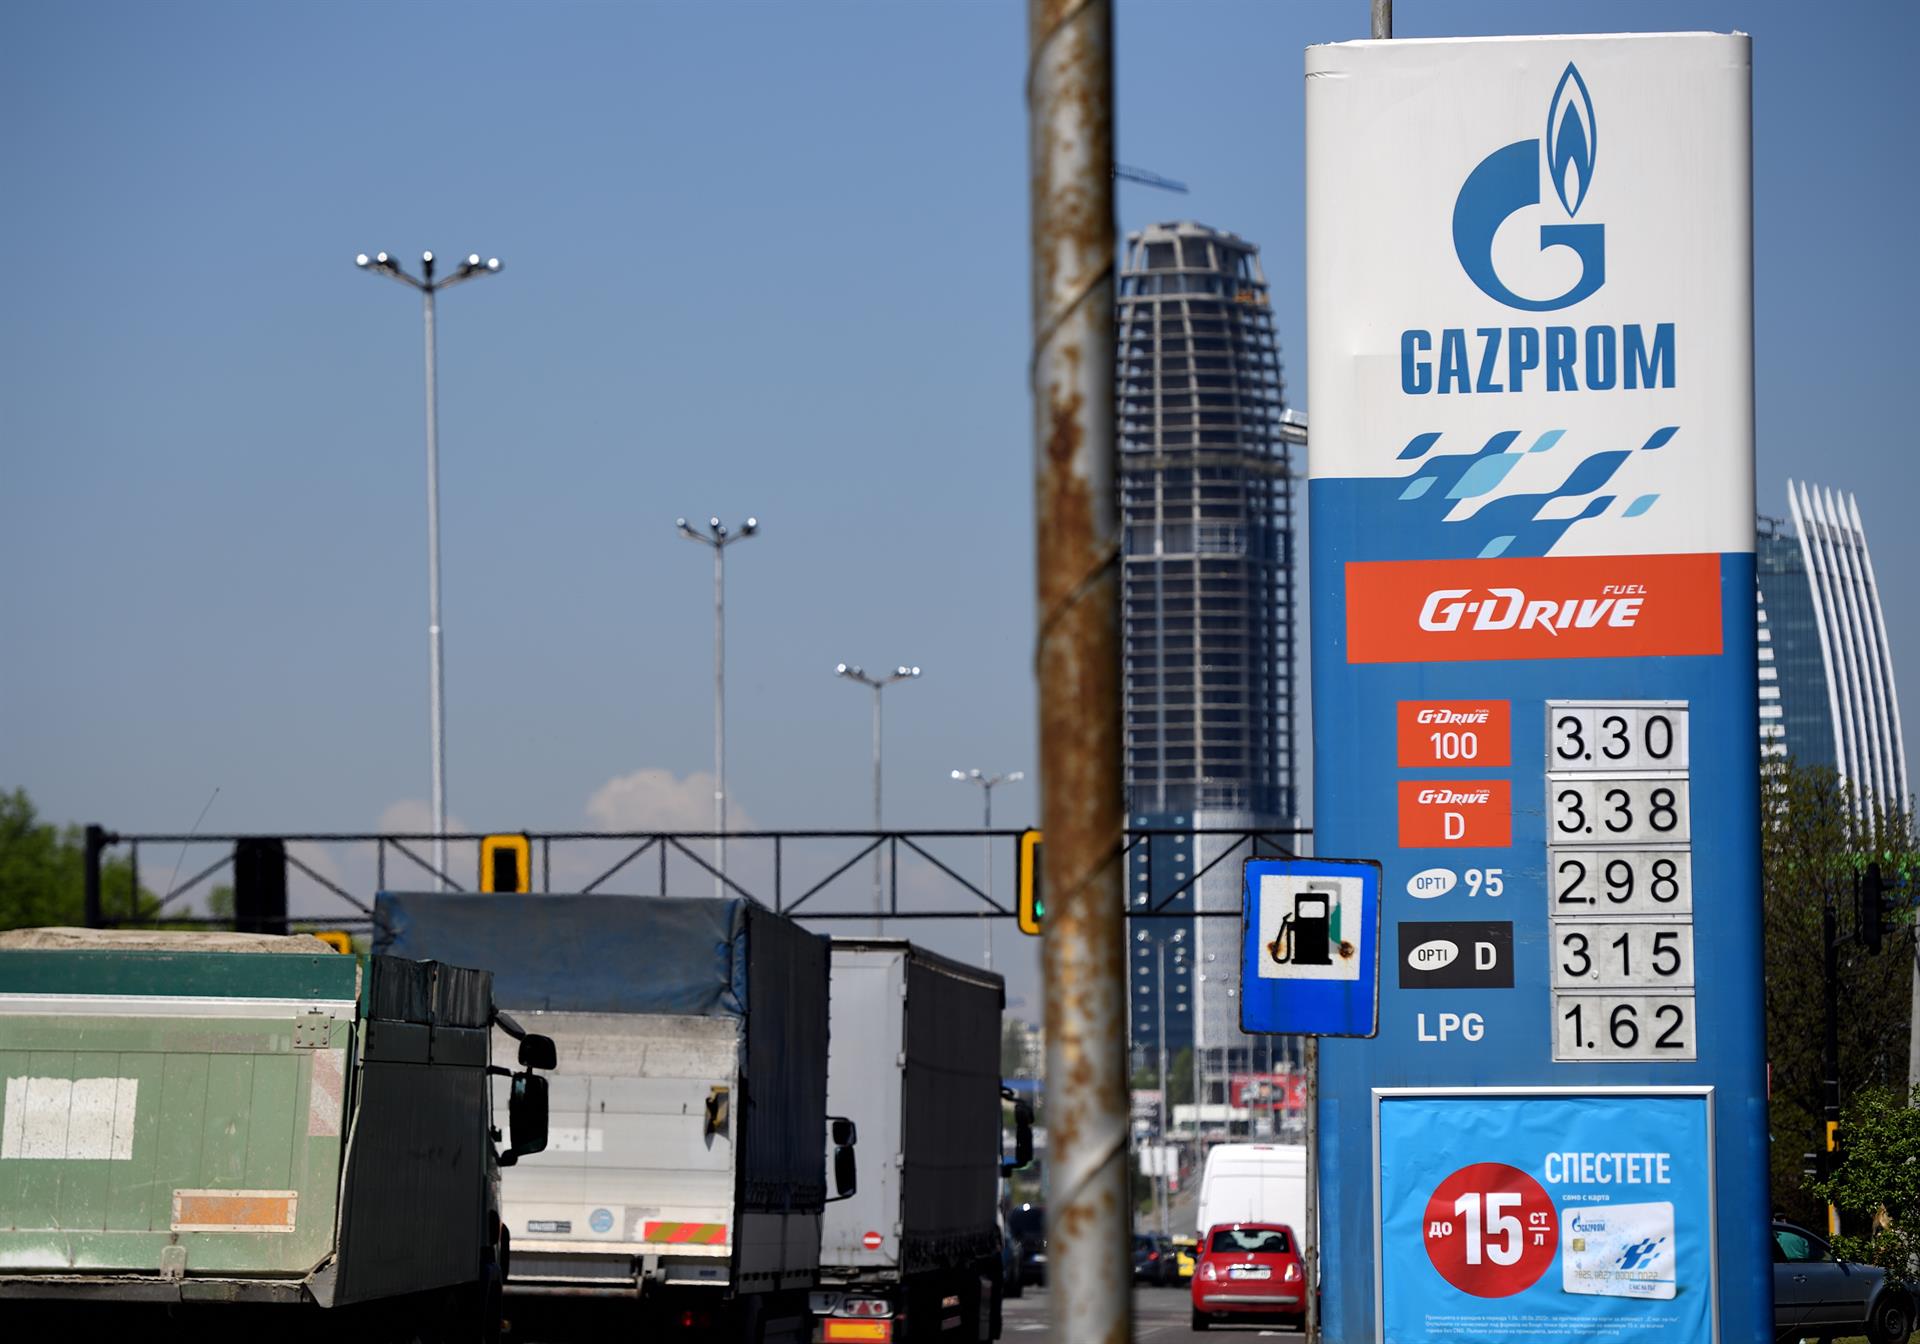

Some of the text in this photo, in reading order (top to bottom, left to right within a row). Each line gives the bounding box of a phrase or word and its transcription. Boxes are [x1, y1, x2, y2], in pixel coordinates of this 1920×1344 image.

[1401, 323, 1676, 395] GAZPROM
[1602, 584, 1647, 595] FUEL
[1430, 732, 1478, 760] 100
[1556, 715, 1674, 760] 3.30
[1557, 788, 1678, 833] 3.38
[1444, 812, 1465, 840] D
[1416, 869, 1504, 898] OPTI 95
[1558, 859, 1680, 905] 2.98
[1418, 942, 1497, 971] OPTI D
[1417, 1013, 1485, 1042] LPG
[1565, 1004, 1685, 1049] 1.62
[1545, 1152, 1671, 1184] СПЕСТЕТЕ
[1454, 1192, 1524, 1266] 15
[1581, 1223, 1606, 1232] GAZPROM
